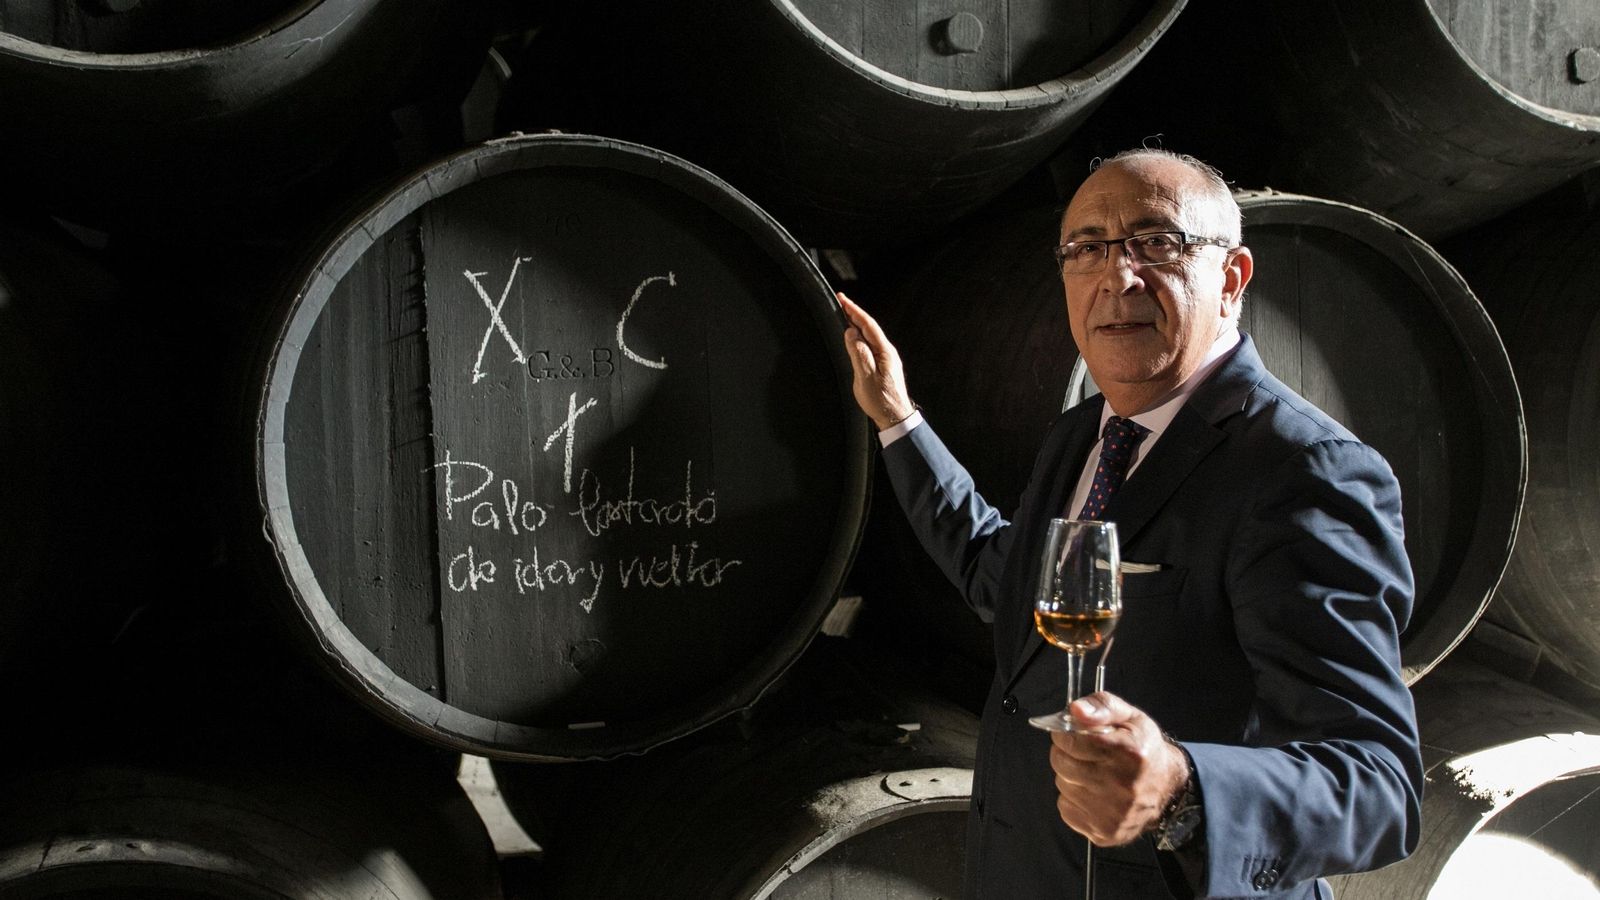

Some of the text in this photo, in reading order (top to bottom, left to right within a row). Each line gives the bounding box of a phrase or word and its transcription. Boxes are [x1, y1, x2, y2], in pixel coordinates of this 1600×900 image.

[463, 256, 677, 385] X C
[421, 449, 547, 535] Palo
[447, 545, 497, 593] de
[513, 546, 585, 595] ida
[579, 560, 604, 614] y
